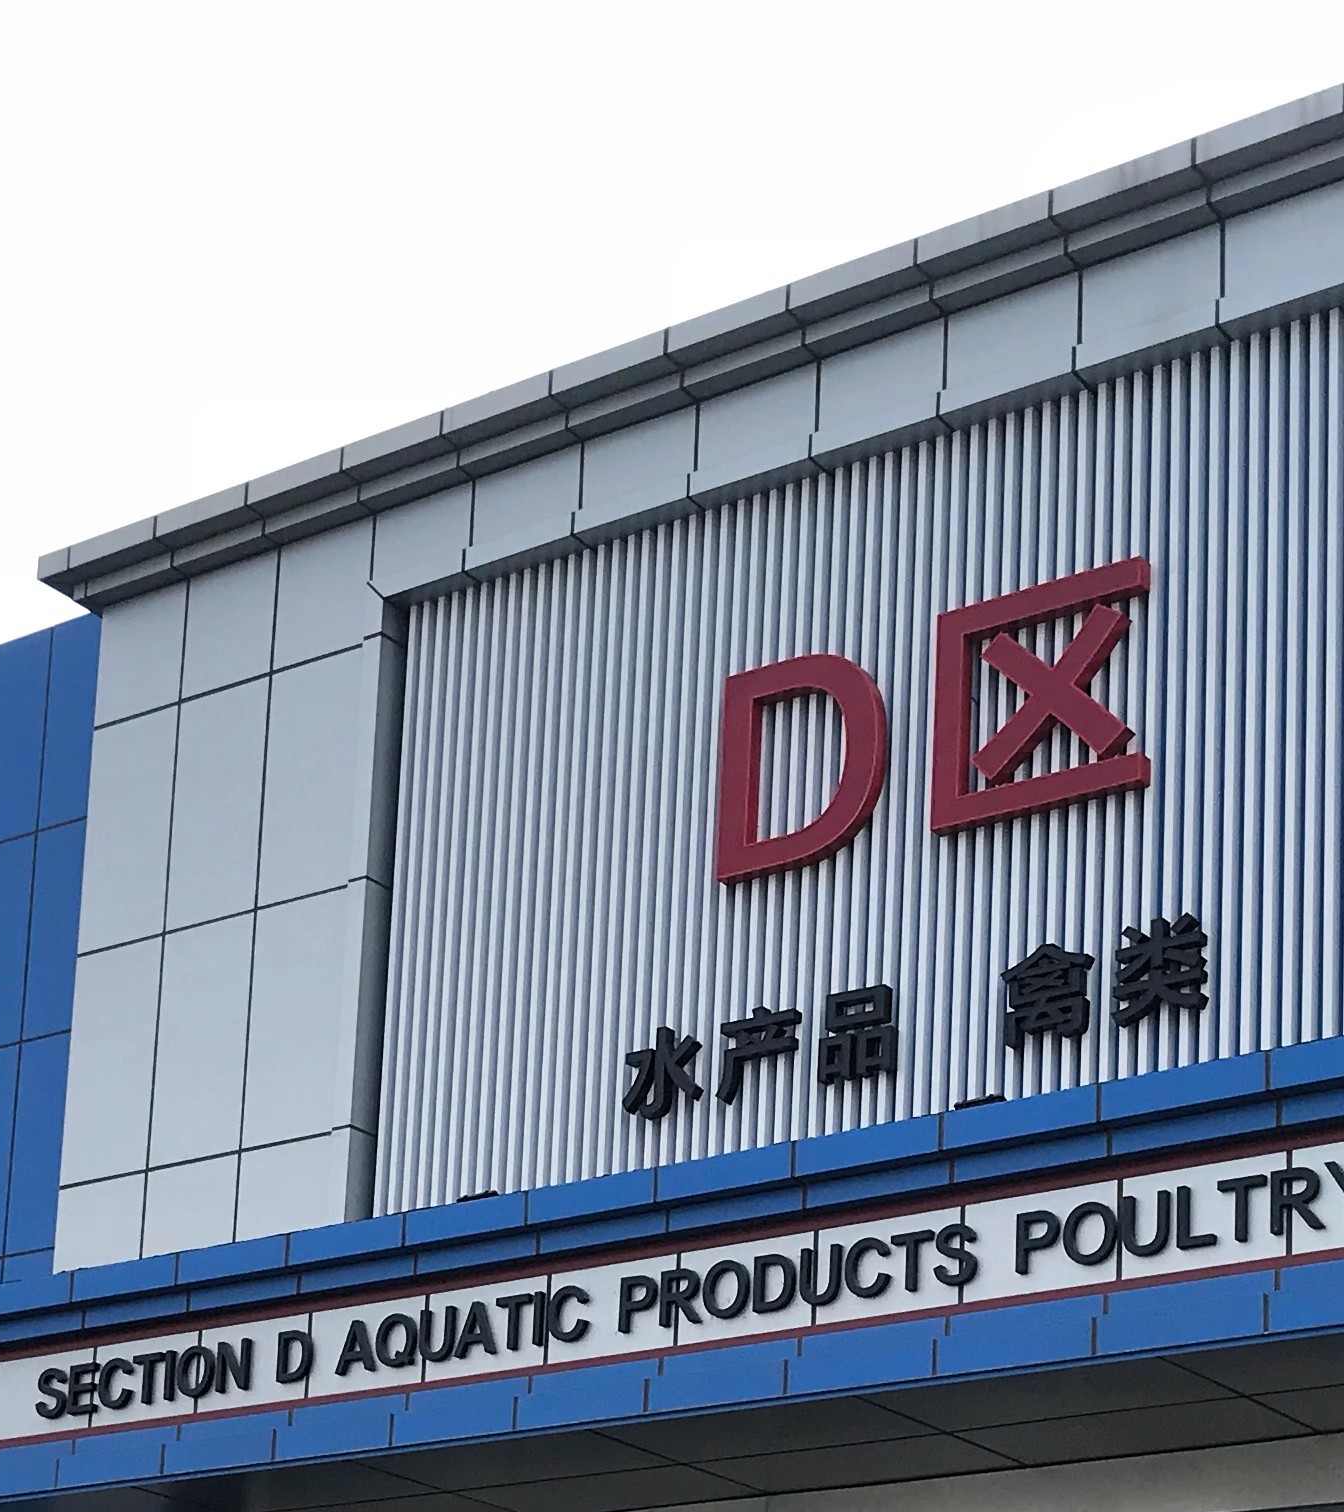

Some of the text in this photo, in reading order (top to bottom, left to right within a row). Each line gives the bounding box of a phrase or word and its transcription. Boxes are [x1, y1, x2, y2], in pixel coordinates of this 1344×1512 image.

[716, 556, 1151, 886] D区
[621, 913, 1210, 1121] 水产品 禽类
[35, 1337, 254, 1420] SECTION
[276, 1329, 314, 1384] D
[335, 1285, 591, 1377] AQUATIC
[617, 1223, 979, 1334] PRODUCTS
